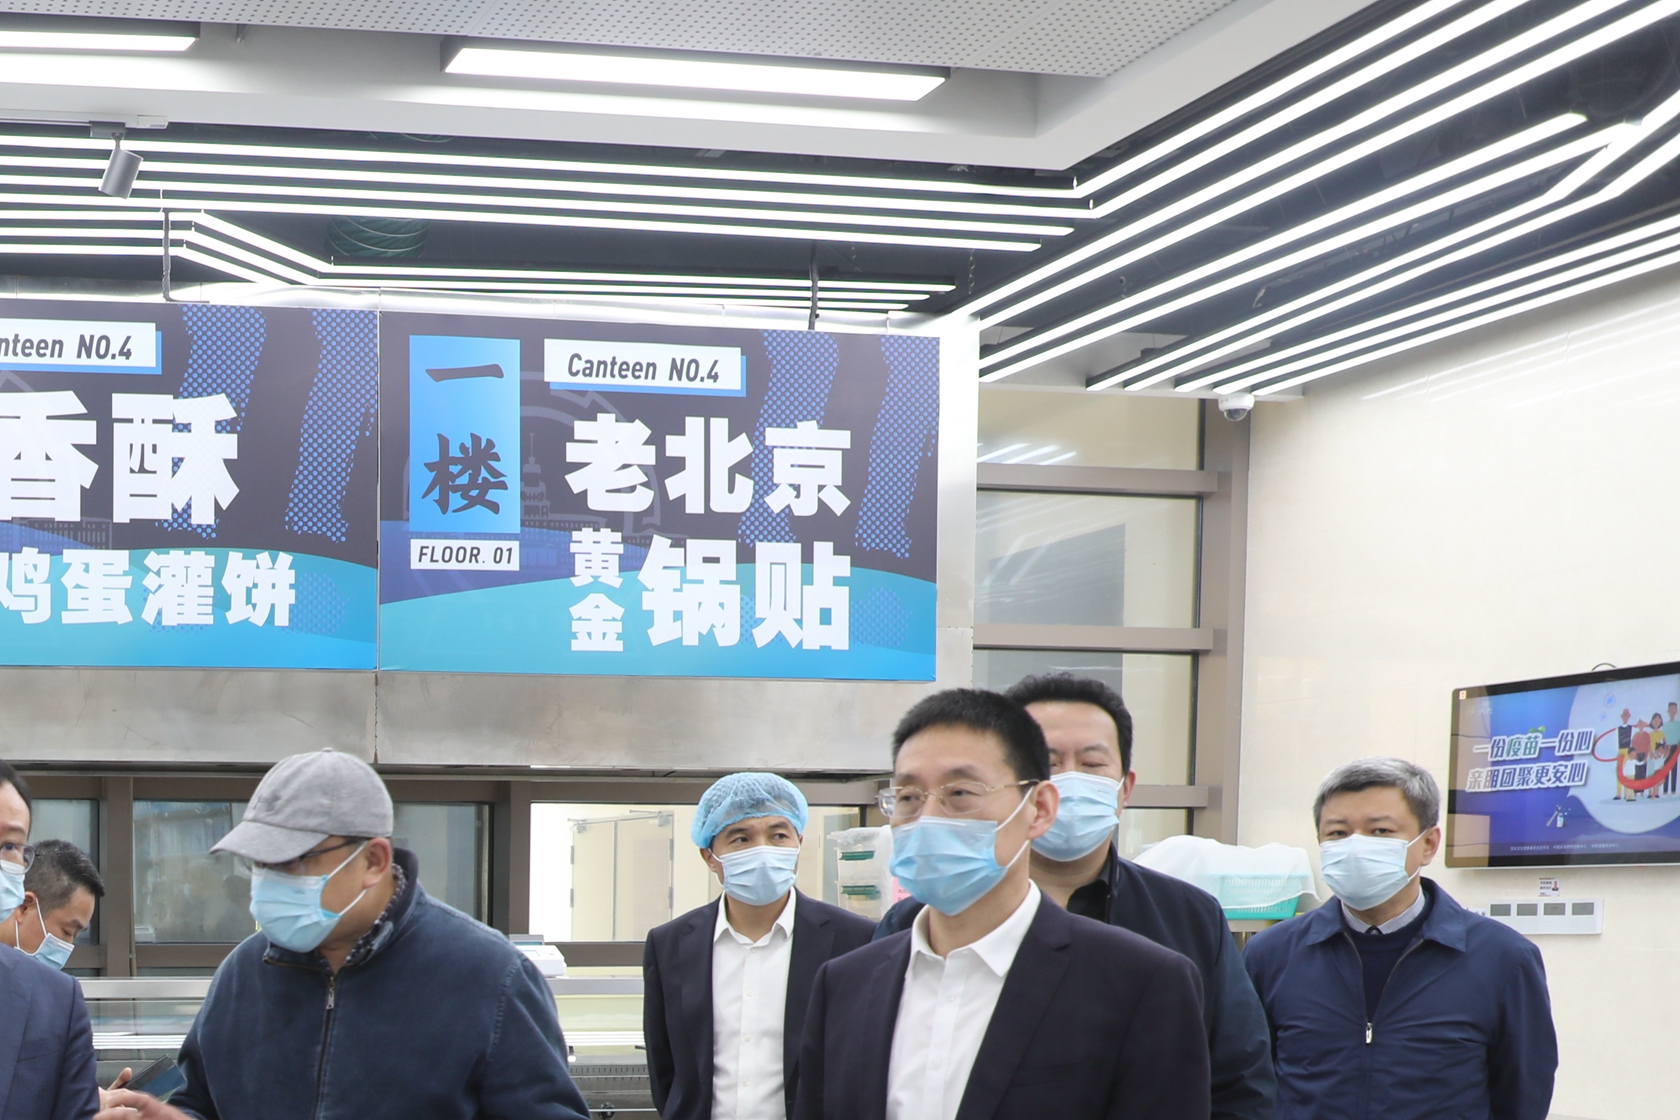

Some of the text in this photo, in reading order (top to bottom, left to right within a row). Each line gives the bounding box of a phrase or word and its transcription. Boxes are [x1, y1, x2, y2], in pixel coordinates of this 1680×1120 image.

[75, 333, 133, 362] NO.4
[566, 352, 721, 384] Canteen NO.4
[565, 412, 852, 518] 老北京
[492, 546, 514, 565] 01
[568, 526, 852, 652] 黄金 锅贴
[1473, 729, 1596, 761] 一份疫苗一份心
[1466, 761, 1589, 792] 亲朋团聚更安心
